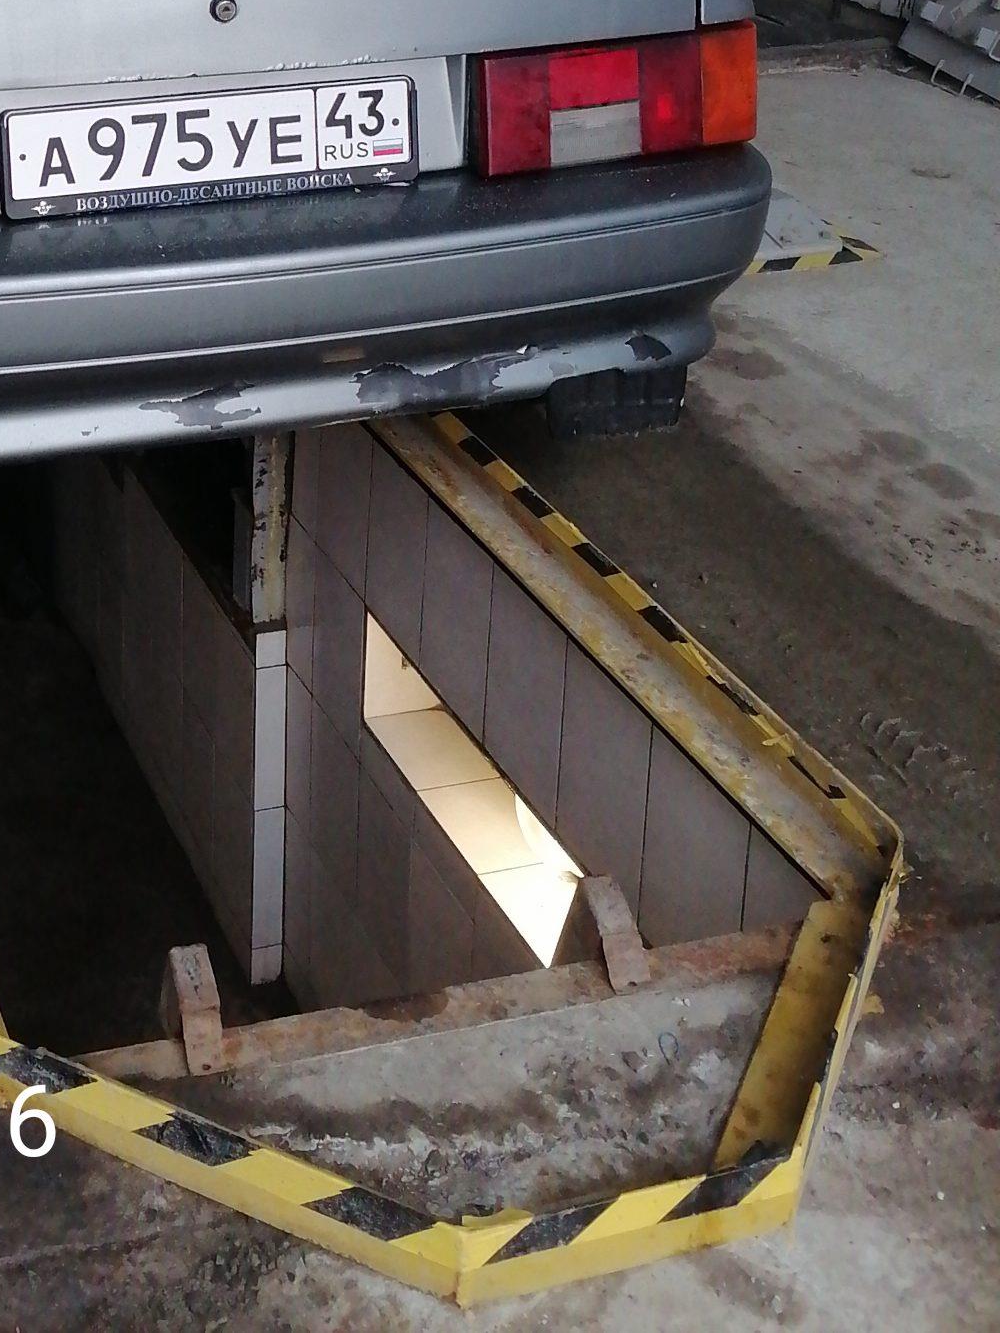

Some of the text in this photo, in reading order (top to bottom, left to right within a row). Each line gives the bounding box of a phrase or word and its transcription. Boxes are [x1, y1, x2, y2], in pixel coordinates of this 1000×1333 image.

[325, 89, 385, 139] 43
[324, 142, 369, 162] RUS
[76, 177, 283, 212] ВОЗДУШНО-ДЕСАНТНЫЕ
